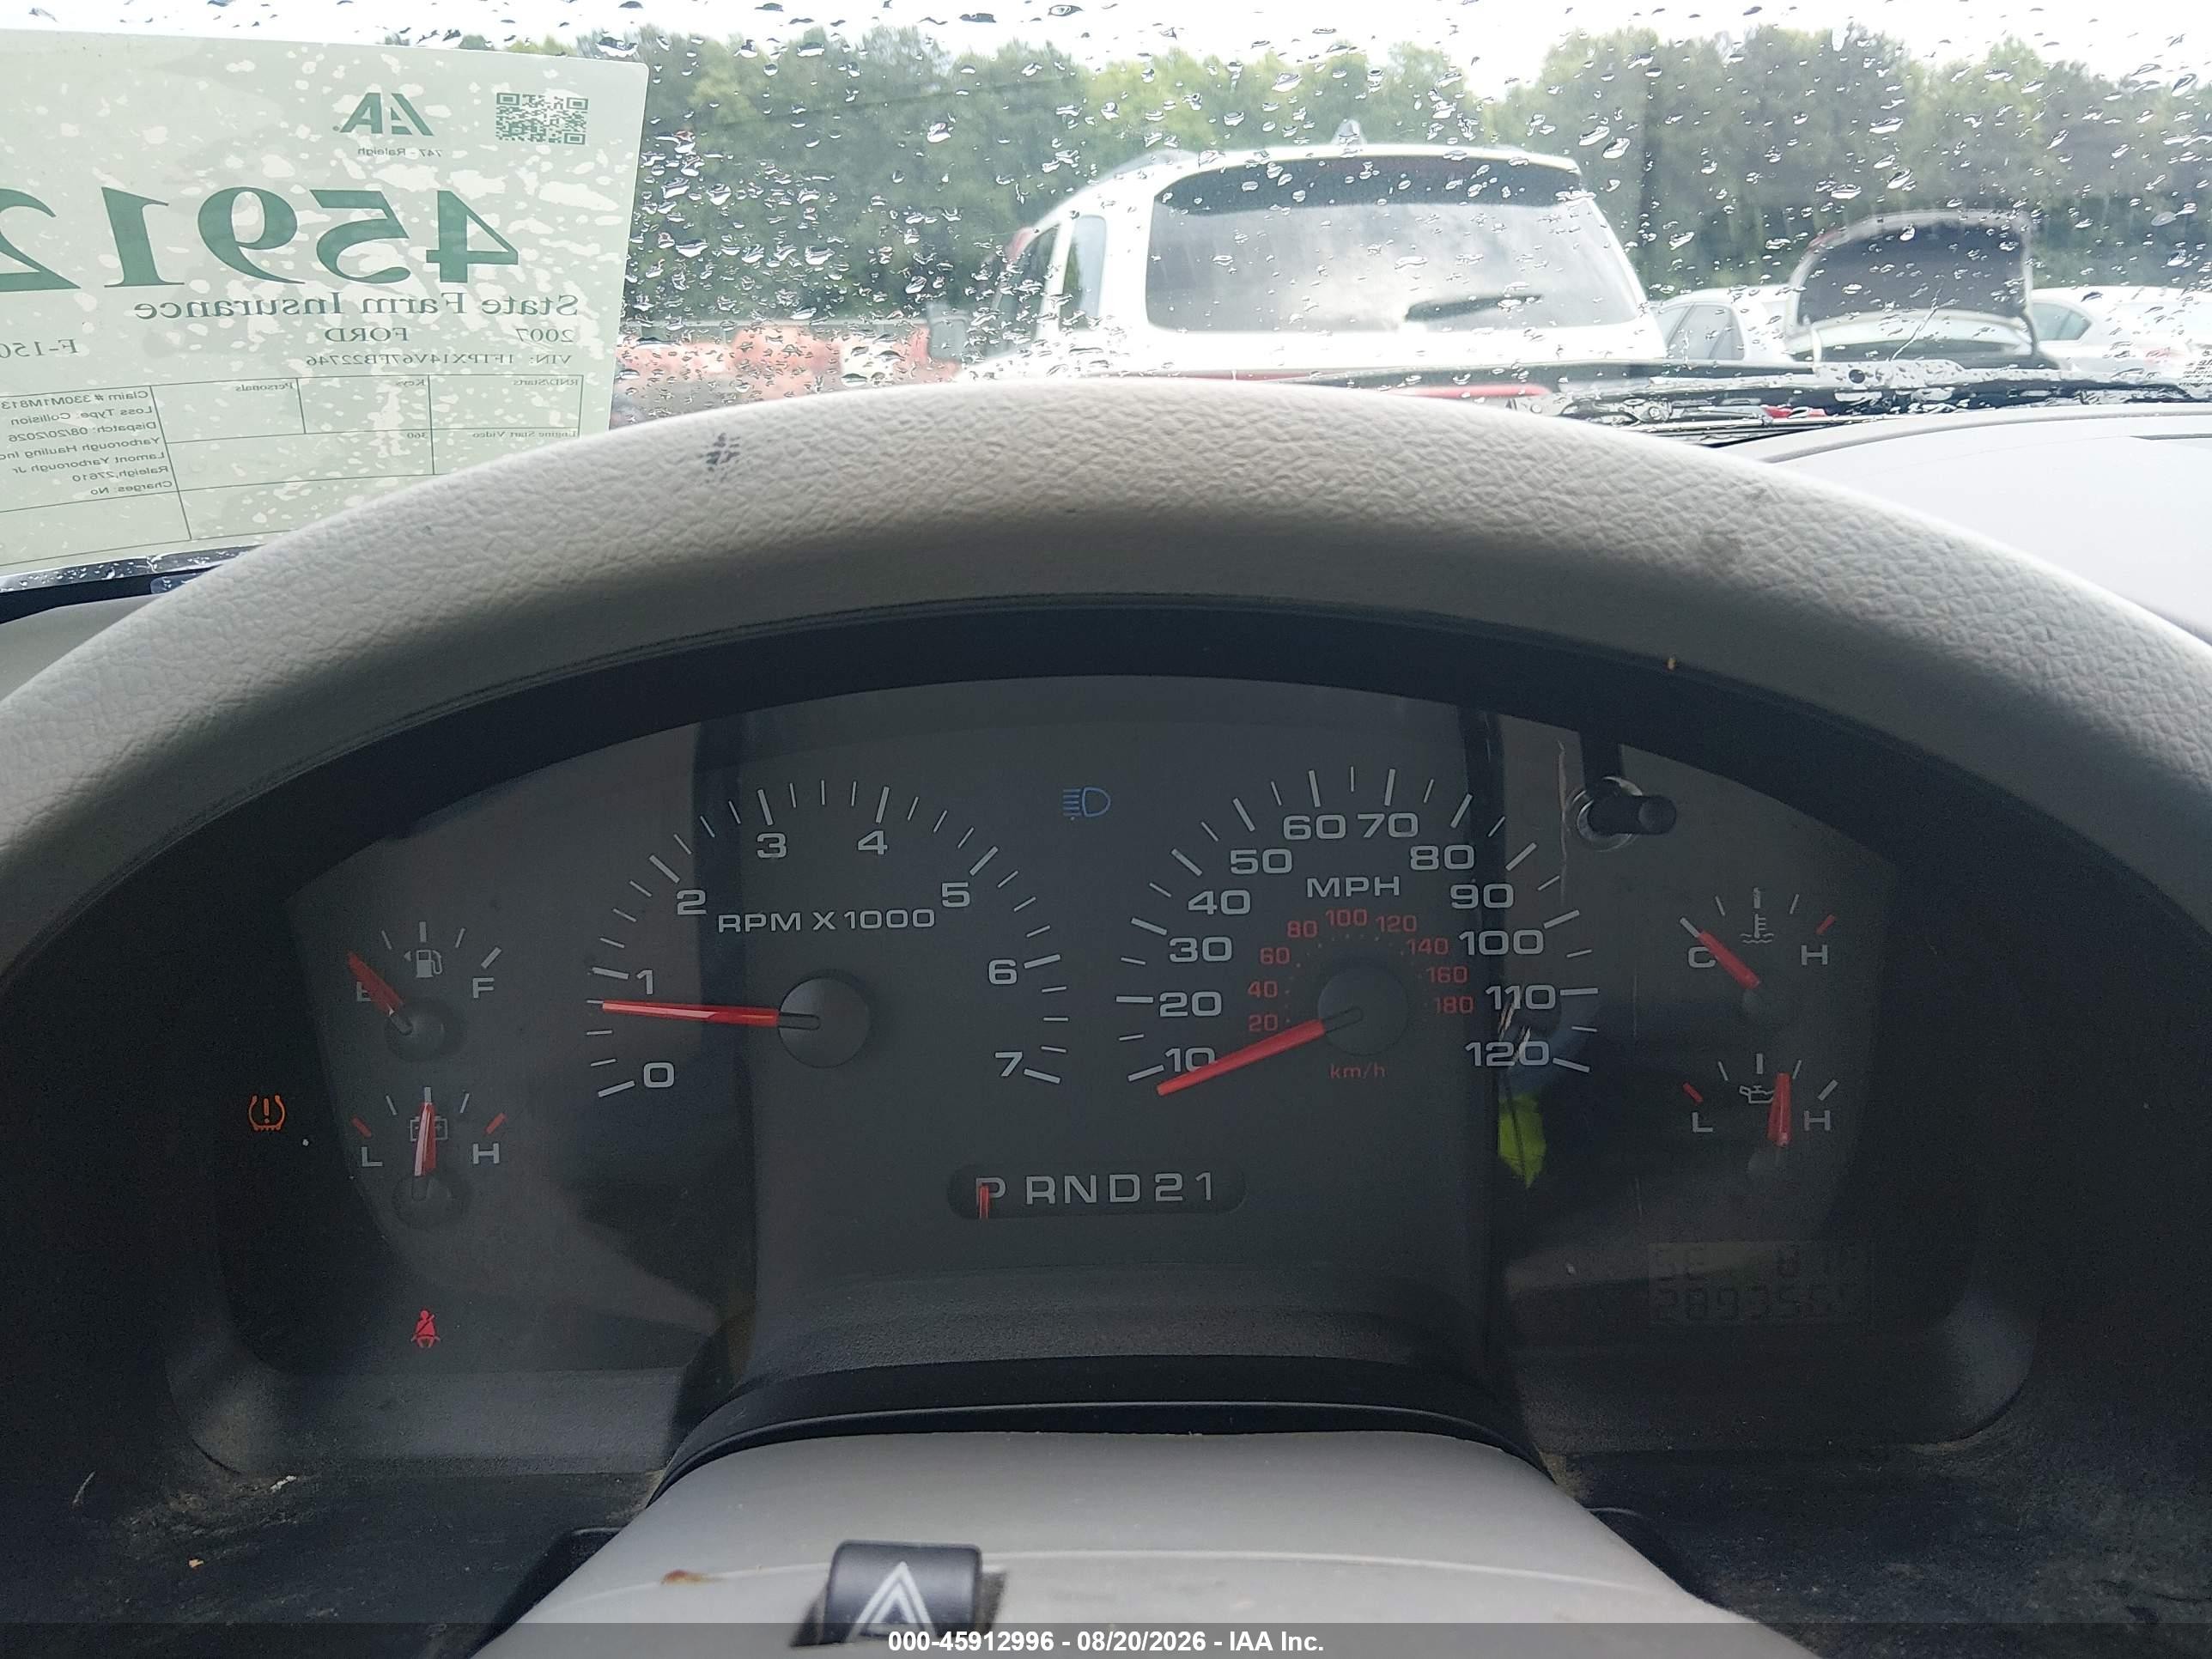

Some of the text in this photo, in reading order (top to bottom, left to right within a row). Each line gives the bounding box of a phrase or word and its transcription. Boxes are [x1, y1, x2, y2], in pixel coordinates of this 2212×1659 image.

[1283, 815, 1346, 841] 60
[1357, 813, 1419, 838] 70
[757, 833, 787, 858] 3
[858, 830, 888, 855] 4
[1230, 848, 1292, 874] 50
[1409, 845, 1474, 871] 80
[941, 882, 970, 907] 5
[1306, 876, 1400, 897] MPH
[1450, 884, 1513, 908] 90
[676, 890, 707, 915] 2
[1188, 890, 1251, 915] 40
[718, 911, 802, 933] RPM
[1287, 921, 1317, 938] 80
[1326, 908, 1368, 927] 100
[1376, 915, 1417, 933] 120
[1169, 937, 1232, 963] 30
[1407, 938, 1449, 955] 140
[1458, 929, 1544, 955] 100
[1260, 947, 1290, 964] 60
[1688, 946, 1716, 968] C
[1802, 945, 1828, 965] H
[636, 970, 653, 994] 1
[988, 959, 1018, 984] 6
[1426, 966, 1468, 983] 160
[473, 977, 495, 999] F
[1249, 981, 1278, 998] 40
[1486, 985, 1556, 1011] 110
[1160, 991, 1222, 1017] 20
[1434, 996, 1474, 1014] 180
[1249, 1014, 1278, 1031] 20
[995, 1052, 1023, 1077] 7
[1165, 1048, 1216, 1073] 10
[1465, 1041, 1549, 1066] 120
[643, 1061, 674, 1088] 0
[1329, 1062, 1386, 1079] km/h
[1692, 1112, 1713, 1133] L
[1804, 1110, 1831, 1131] H
[362, 1146, 383, 1167] L
[473, 1143, 500, 1164] H
